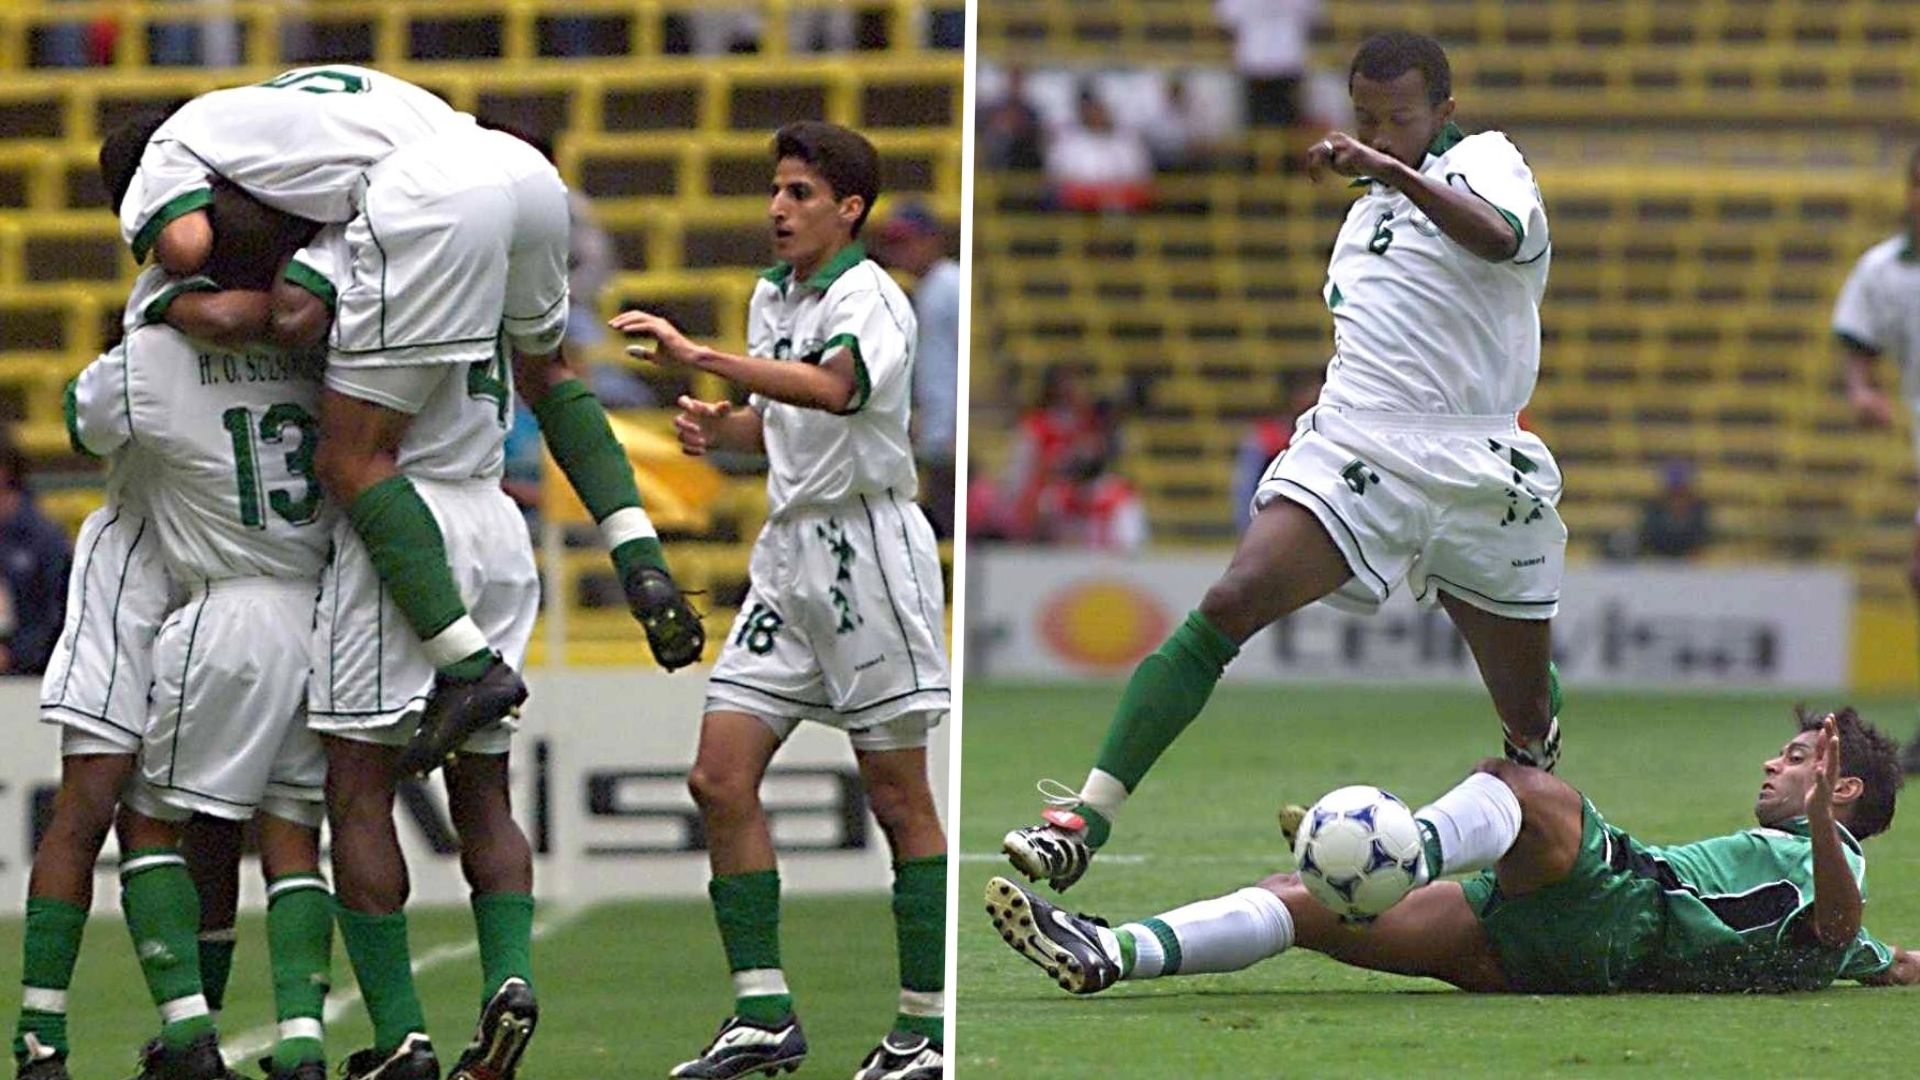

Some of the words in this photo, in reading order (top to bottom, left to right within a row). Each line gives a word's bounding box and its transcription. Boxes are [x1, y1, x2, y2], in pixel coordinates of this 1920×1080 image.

[1368, 210, 1394, 256] 6
[222, 403, 322, 530] 13
[734, 603, 784, 656] 18
